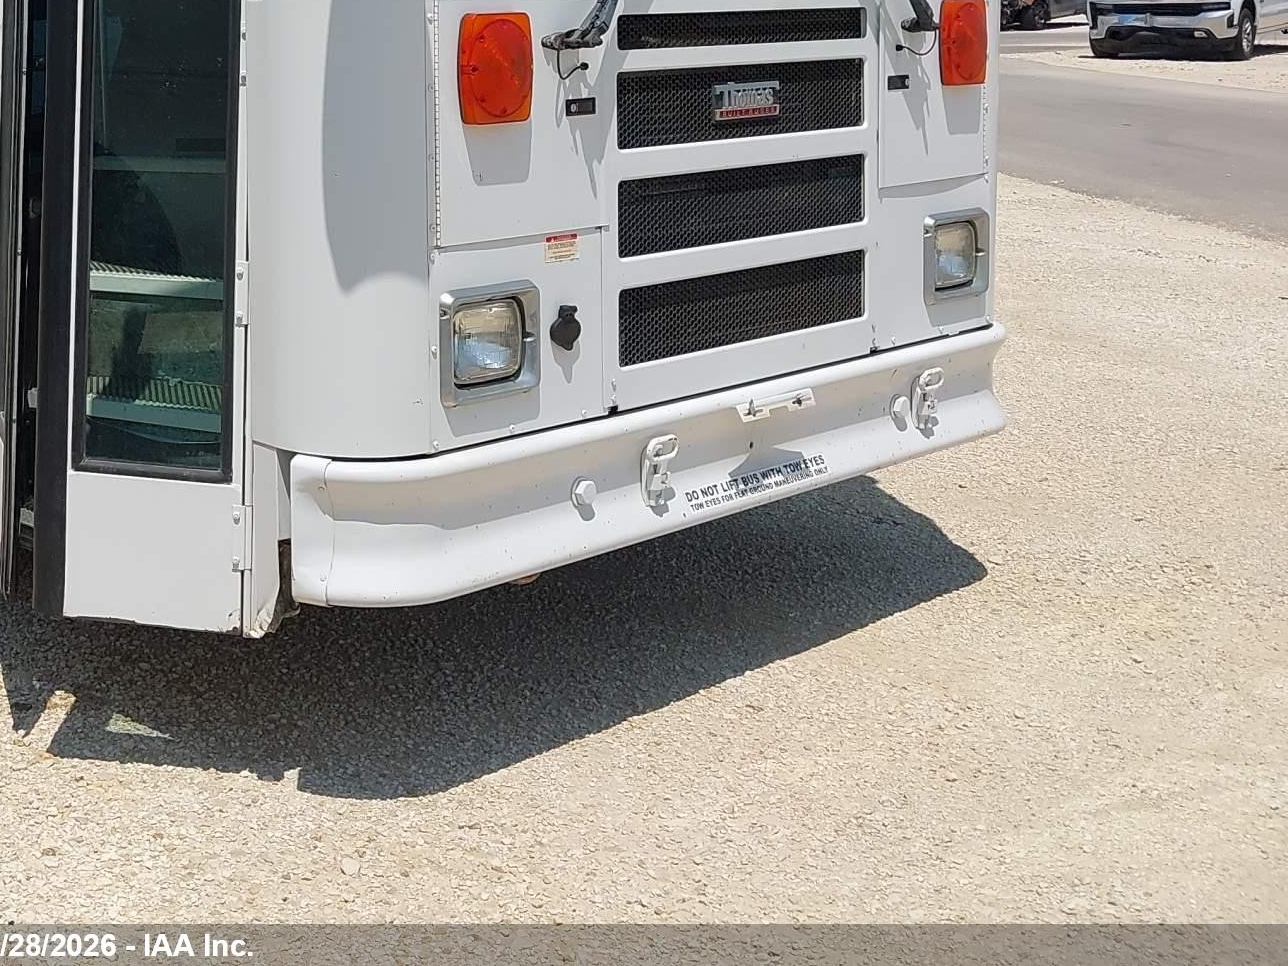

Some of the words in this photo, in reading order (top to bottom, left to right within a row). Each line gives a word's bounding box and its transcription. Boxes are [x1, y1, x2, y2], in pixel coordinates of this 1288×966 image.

[685, 490, 699, 502] DO
[700, 484, 719, 498] NOT
[720, 478, 739, 493] LIFT
[741, 473, 760, 487] BUS
[760, 466, 783, 481] WITH
[783, 460, 803, 474] TOW
[803, 454, 825, 469] EYES
[690, 502, 705, 512] TOW
[705, 497, 721, 507] EYES
[721, 493, 734, 503] FOR
[734, 489, 749, 499] FLAT
[749, 482, 773, 494] GROUND
[774, 470, 813, 487] MANEUVERING
[814, 466, 828, 476] ONLY
